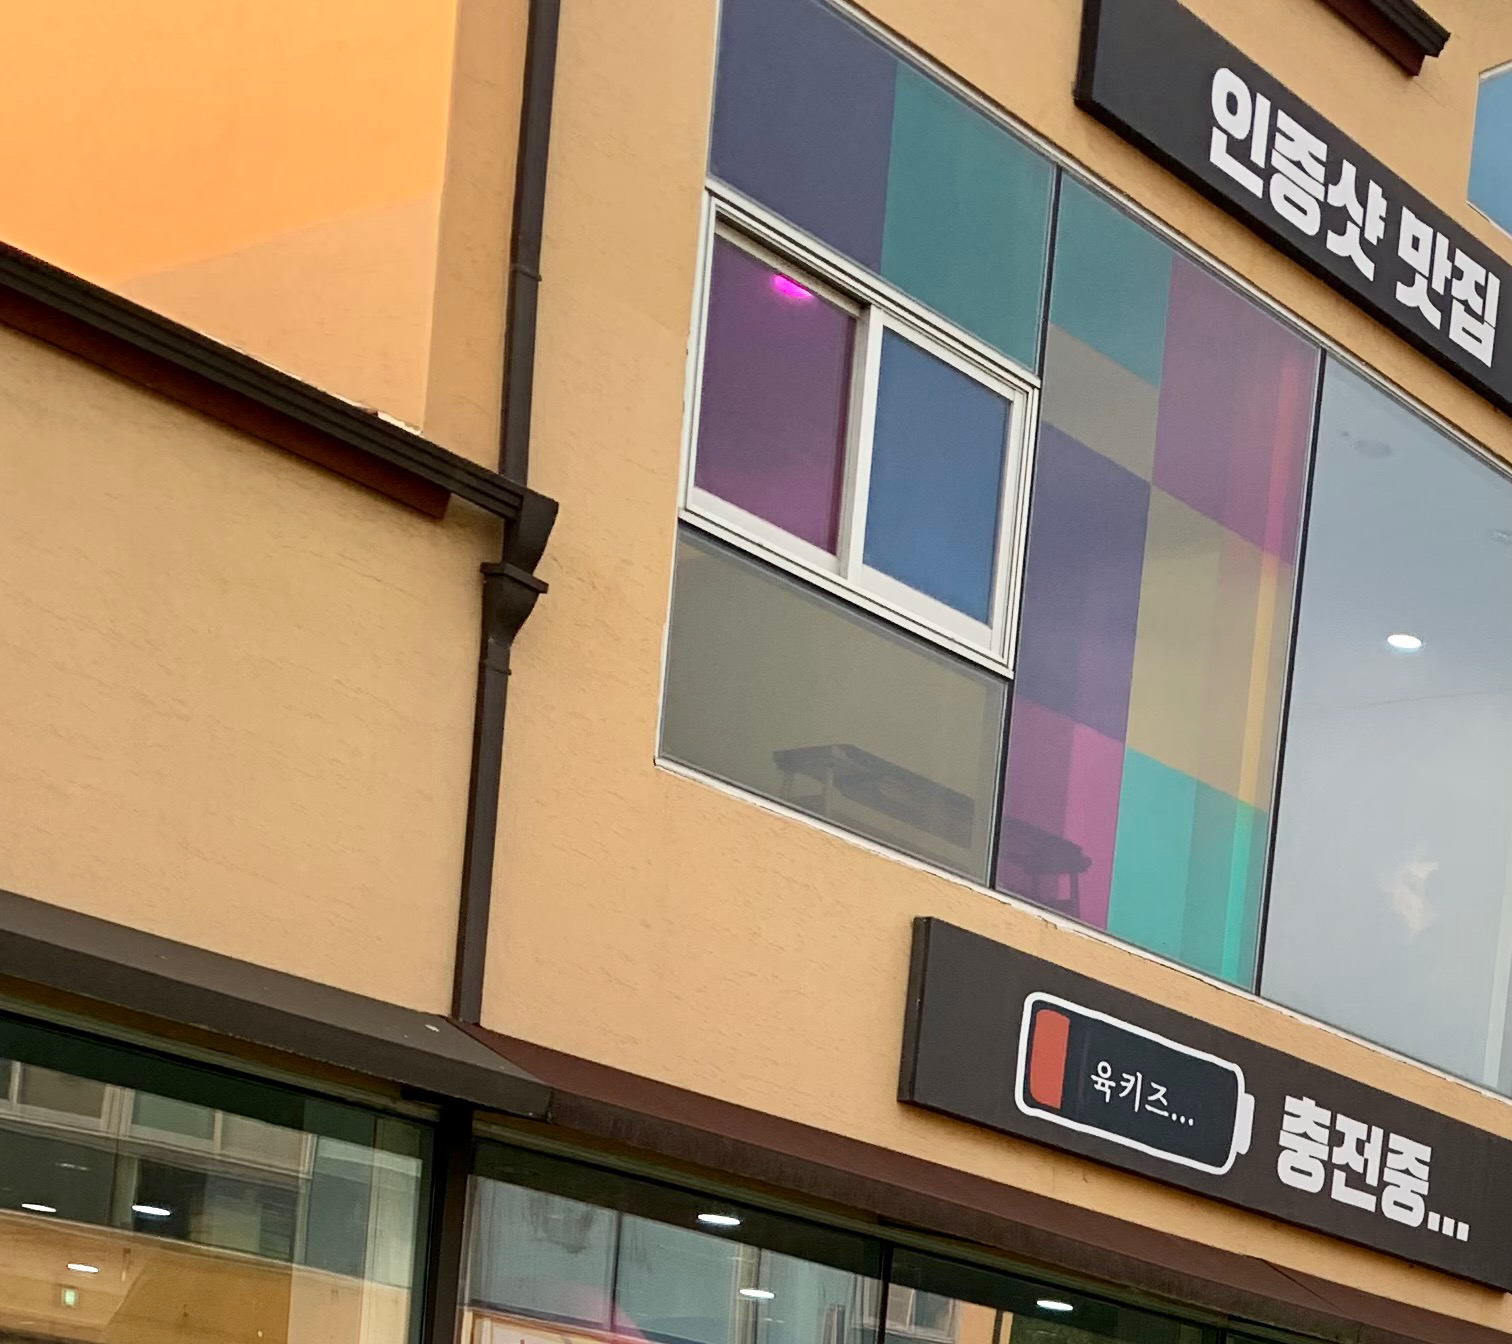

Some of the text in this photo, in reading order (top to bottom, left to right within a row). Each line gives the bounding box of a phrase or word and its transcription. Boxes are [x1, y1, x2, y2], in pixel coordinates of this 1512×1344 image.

[1209, 67, 1501, 368] 인증샷 맛집
[1277, 1095, 1470, 1242] 충전중...
